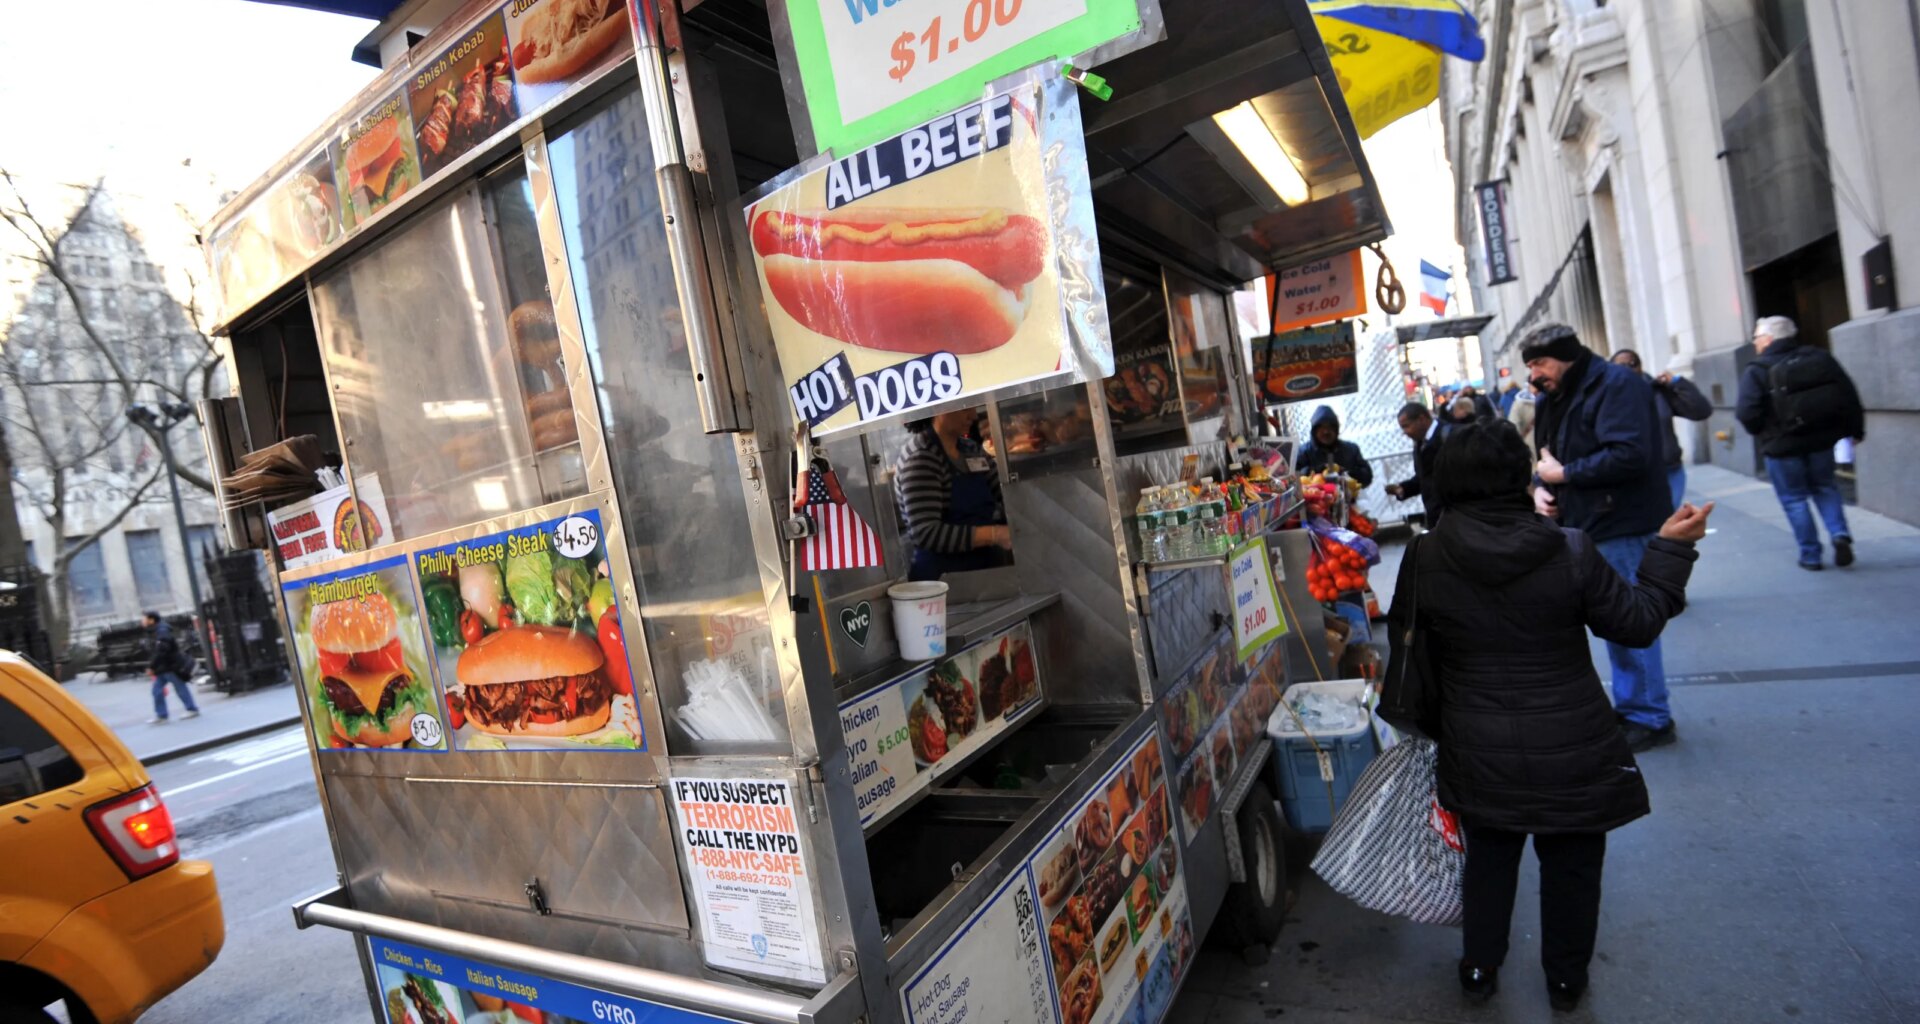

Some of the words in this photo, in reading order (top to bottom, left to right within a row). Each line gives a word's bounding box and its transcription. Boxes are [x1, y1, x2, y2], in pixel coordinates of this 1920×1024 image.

[888, 0, 1023, 83] $1.00
[417, 60, 447, 90] Shish
[449, 30, 485, 66] Kebab
[828, 146, 891, 210] ALL
[901, 94, 1011, 179] BEEF
[1483, 187, 1508, 279] BORDERS
[1302, 260, 1331, 276] Cold
[1284, 283, 1322, 299] Water
[1295, 295, 1341, 316] $1.00
[790, 356, 848, 422] HOT
[855, 352, 962, 421] DOGS
[553, 522, 597, 551] $4.50
[419, 551, 454, 576] Philly
[456, 540, 505, 569] Cheese
[507, 528, 548, 558] Steak
[310, 572, 379, 607] Hamburger
[1237, 588, 1253, 608] Water
[846, 613, 870, 633] NYC
[1244, 606, 1267, 636] $1.00
[413, 720, 442, 742] $3.00
[843, 704, 880, 734] hicken
[851, 760, 879, 786] alian
[675, 781, 689, 802] IF
[691, 781, 720, 803] YOU
[721, 783, 786, 806] SUSPECT
[857, 775, 896, 810] ausage
[680, 802, 795, 833] TERRORISM
[686, 829, 724, 848] CALL
[724, 831, 755, 851] THE
[756, 833, 798, 854] NYPD
[690, 847, 803, 876] 1-888-NYC-SAFE
[706, 869, 793, 889] (1-888-692-7233)
[722, 884, 734, 892] calls
[734, 885, 743, 893] will
[743, 886, 749, 894] be
[749, 887, 759, 896] kept
[759, 886, 787, 898] confidential
[1020, 918, 1036, 944] 2.00
[383, 946, 413, 967] Chicken
[424, 958, 443, 976] Rice
[466, 967, 495, 989] Italian
[496, 976, 538, 1002] Sausage
[917, 989, 934, 1015] Hot
[938, 973, 956, 998] Dog
[943, 976, 975, 1018] Sausage
[591, 998, 636, 1024] GYRO
